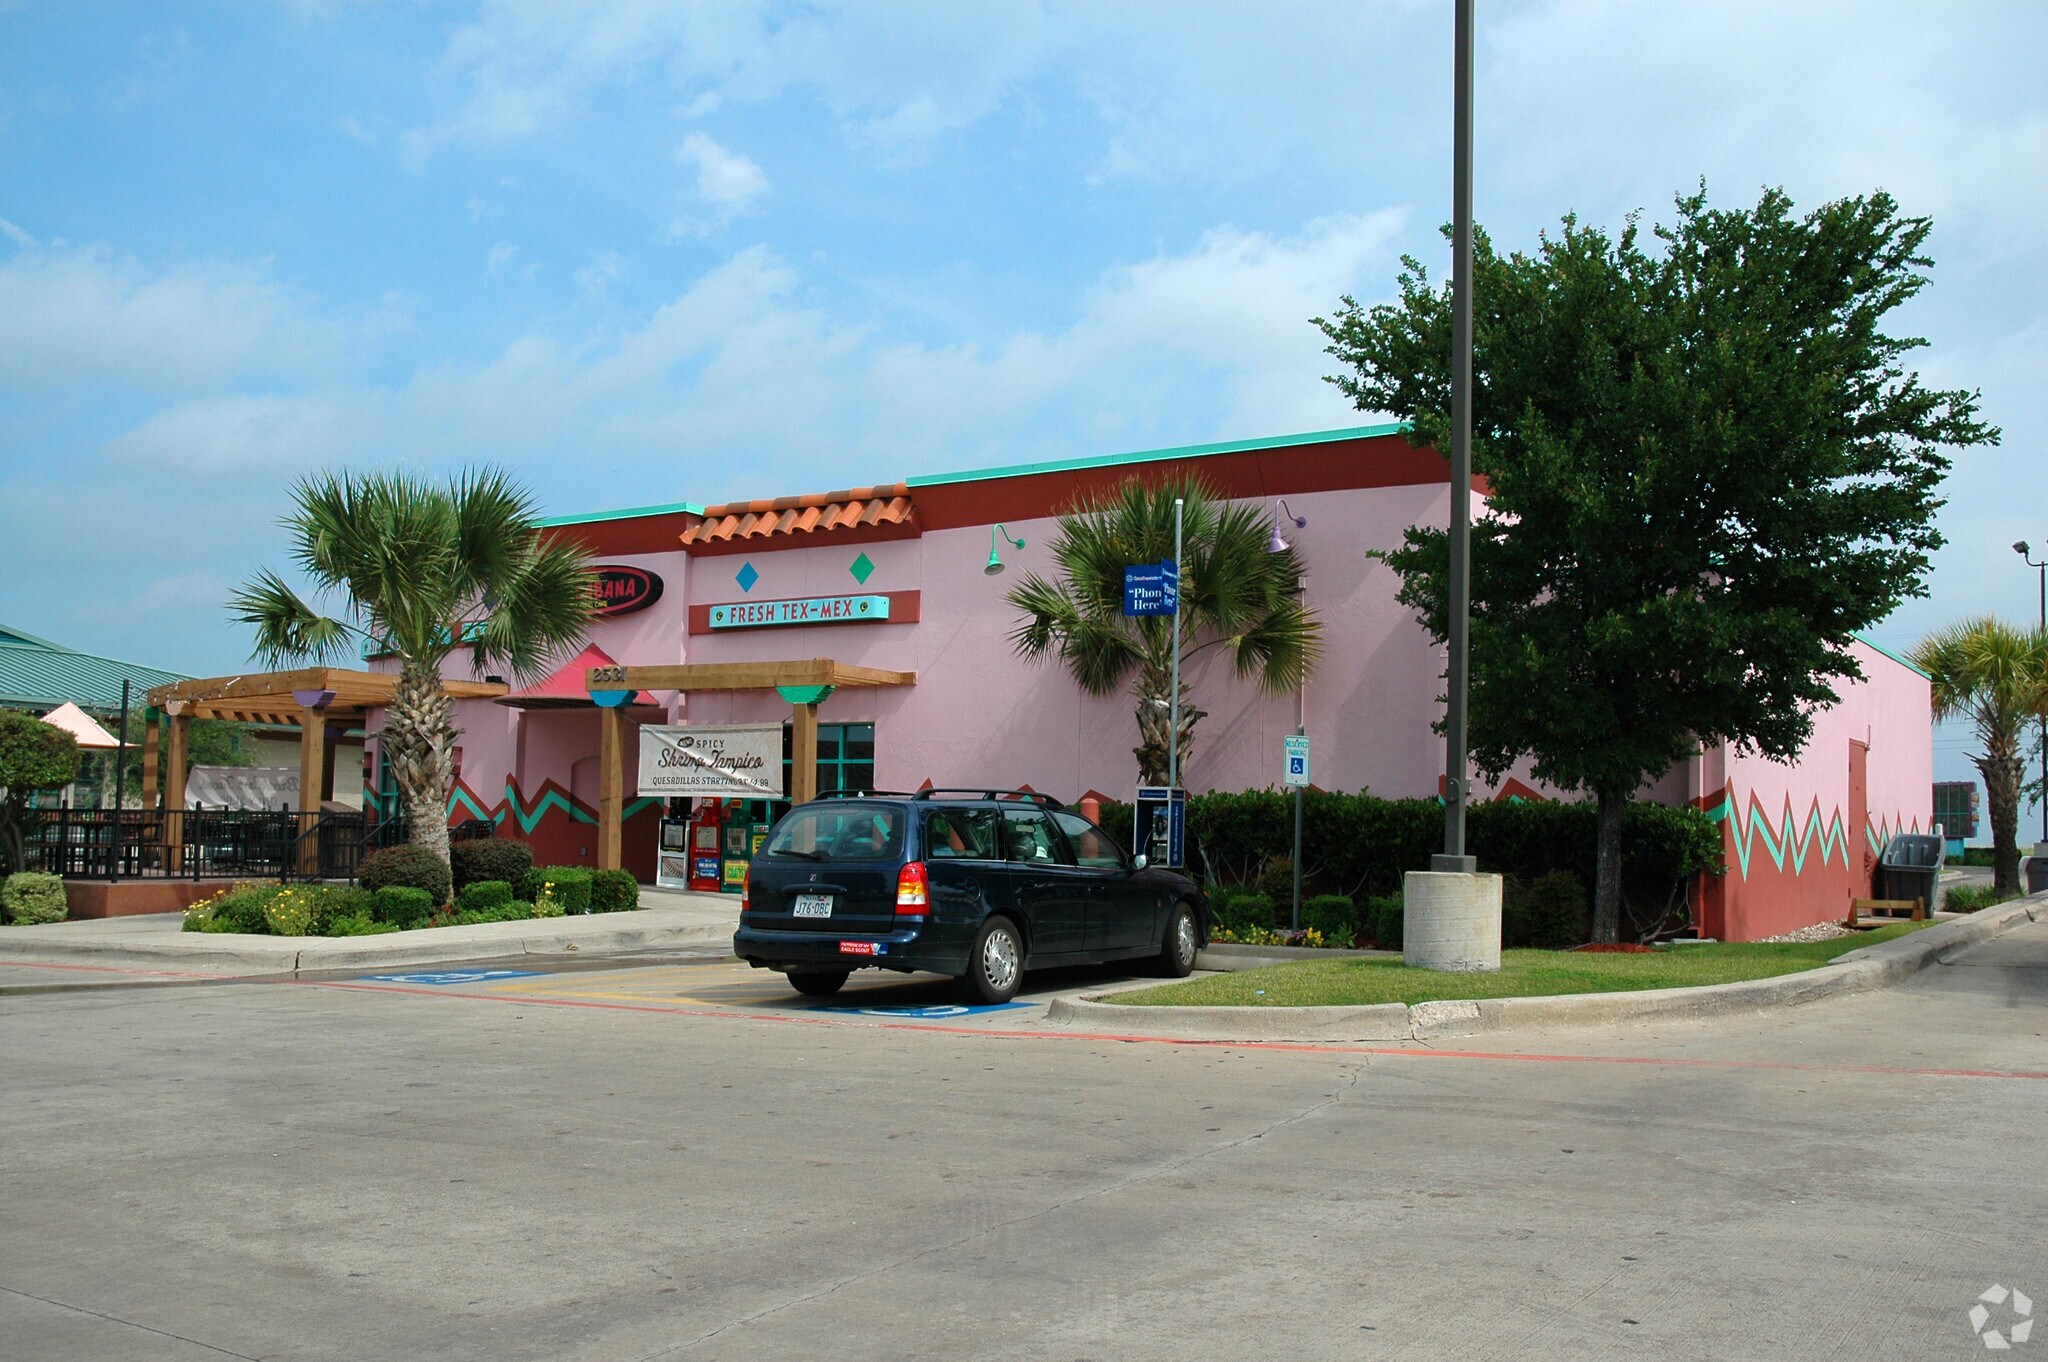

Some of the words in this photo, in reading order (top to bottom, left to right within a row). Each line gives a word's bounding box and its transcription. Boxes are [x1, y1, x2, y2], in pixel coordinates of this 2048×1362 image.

[729, 605, 775, 624] FRESH
[782, 599, 853, 621] TEX-MEX
[696, 739, 725, 748] SPICY
[658, 748, 706, 773] Shrimp
[708, 749, 764, 774] Tampico
[652, 776, 700, 786] QUESADILLAS
